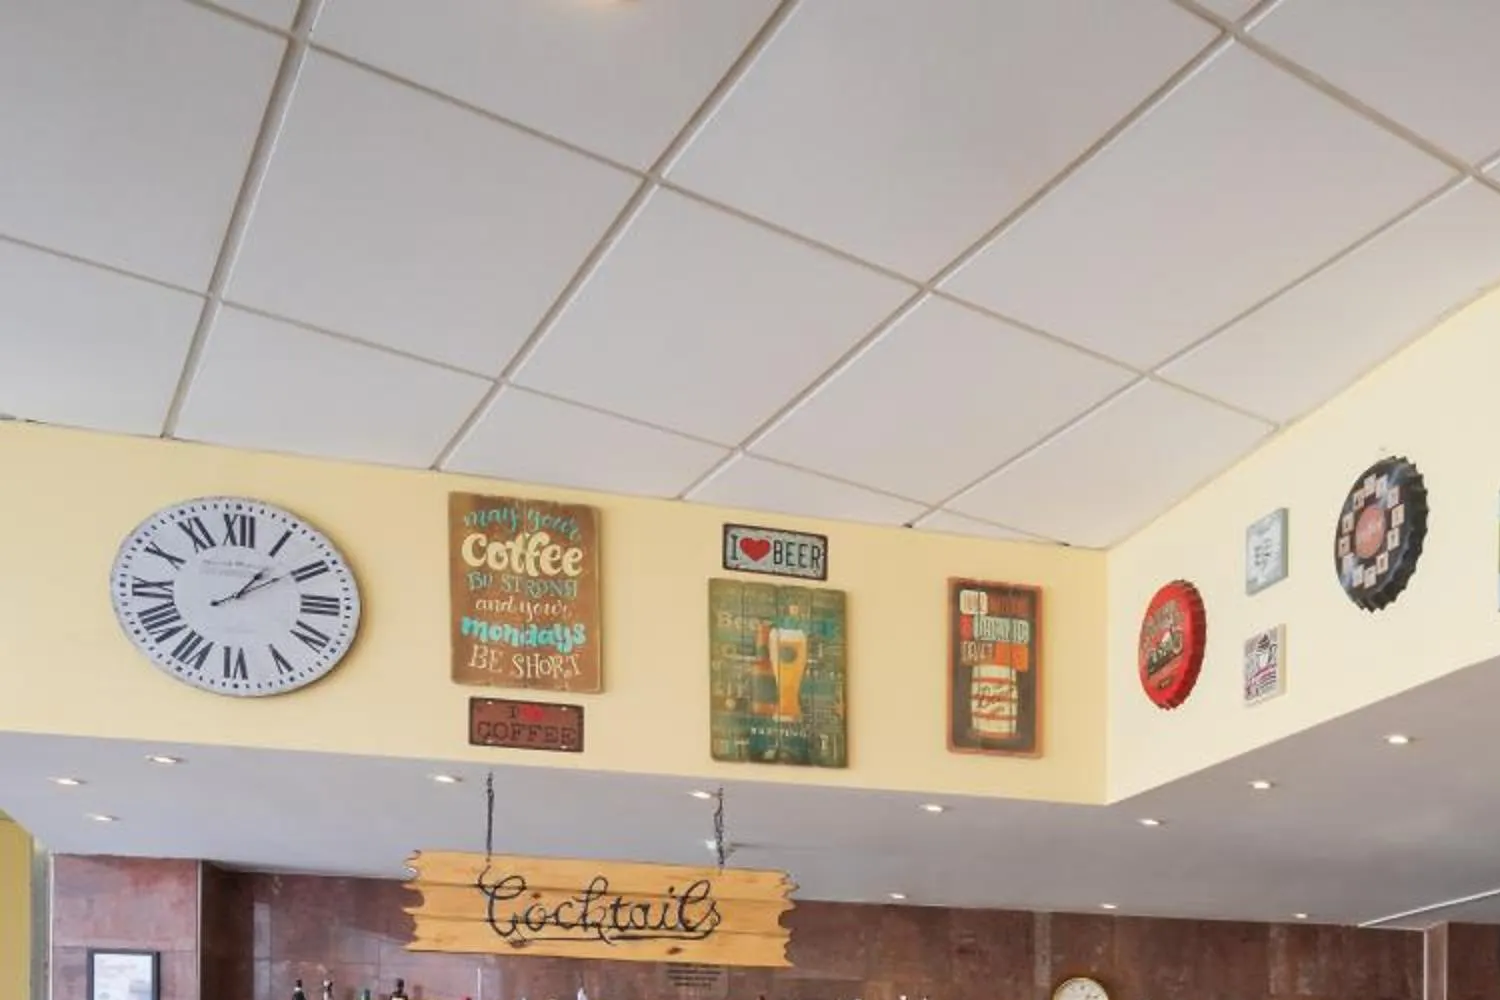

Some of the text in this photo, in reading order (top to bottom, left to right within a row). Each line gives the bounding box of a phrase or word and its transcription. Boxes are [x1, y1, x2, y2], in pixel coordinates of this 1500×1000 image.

[464, 507, 519, 531] may
[730, 533, 822, 570] I BEER
[501, 574, 578, 599] STRONG
[475, 596, 514, 614] and
[461, 615, 586, 654] mondays
[468, 644, 583, 680] BE SHORT
[476, 720, 577, 746] COFFEE
[477, 868, 723, 946] Cocktails
